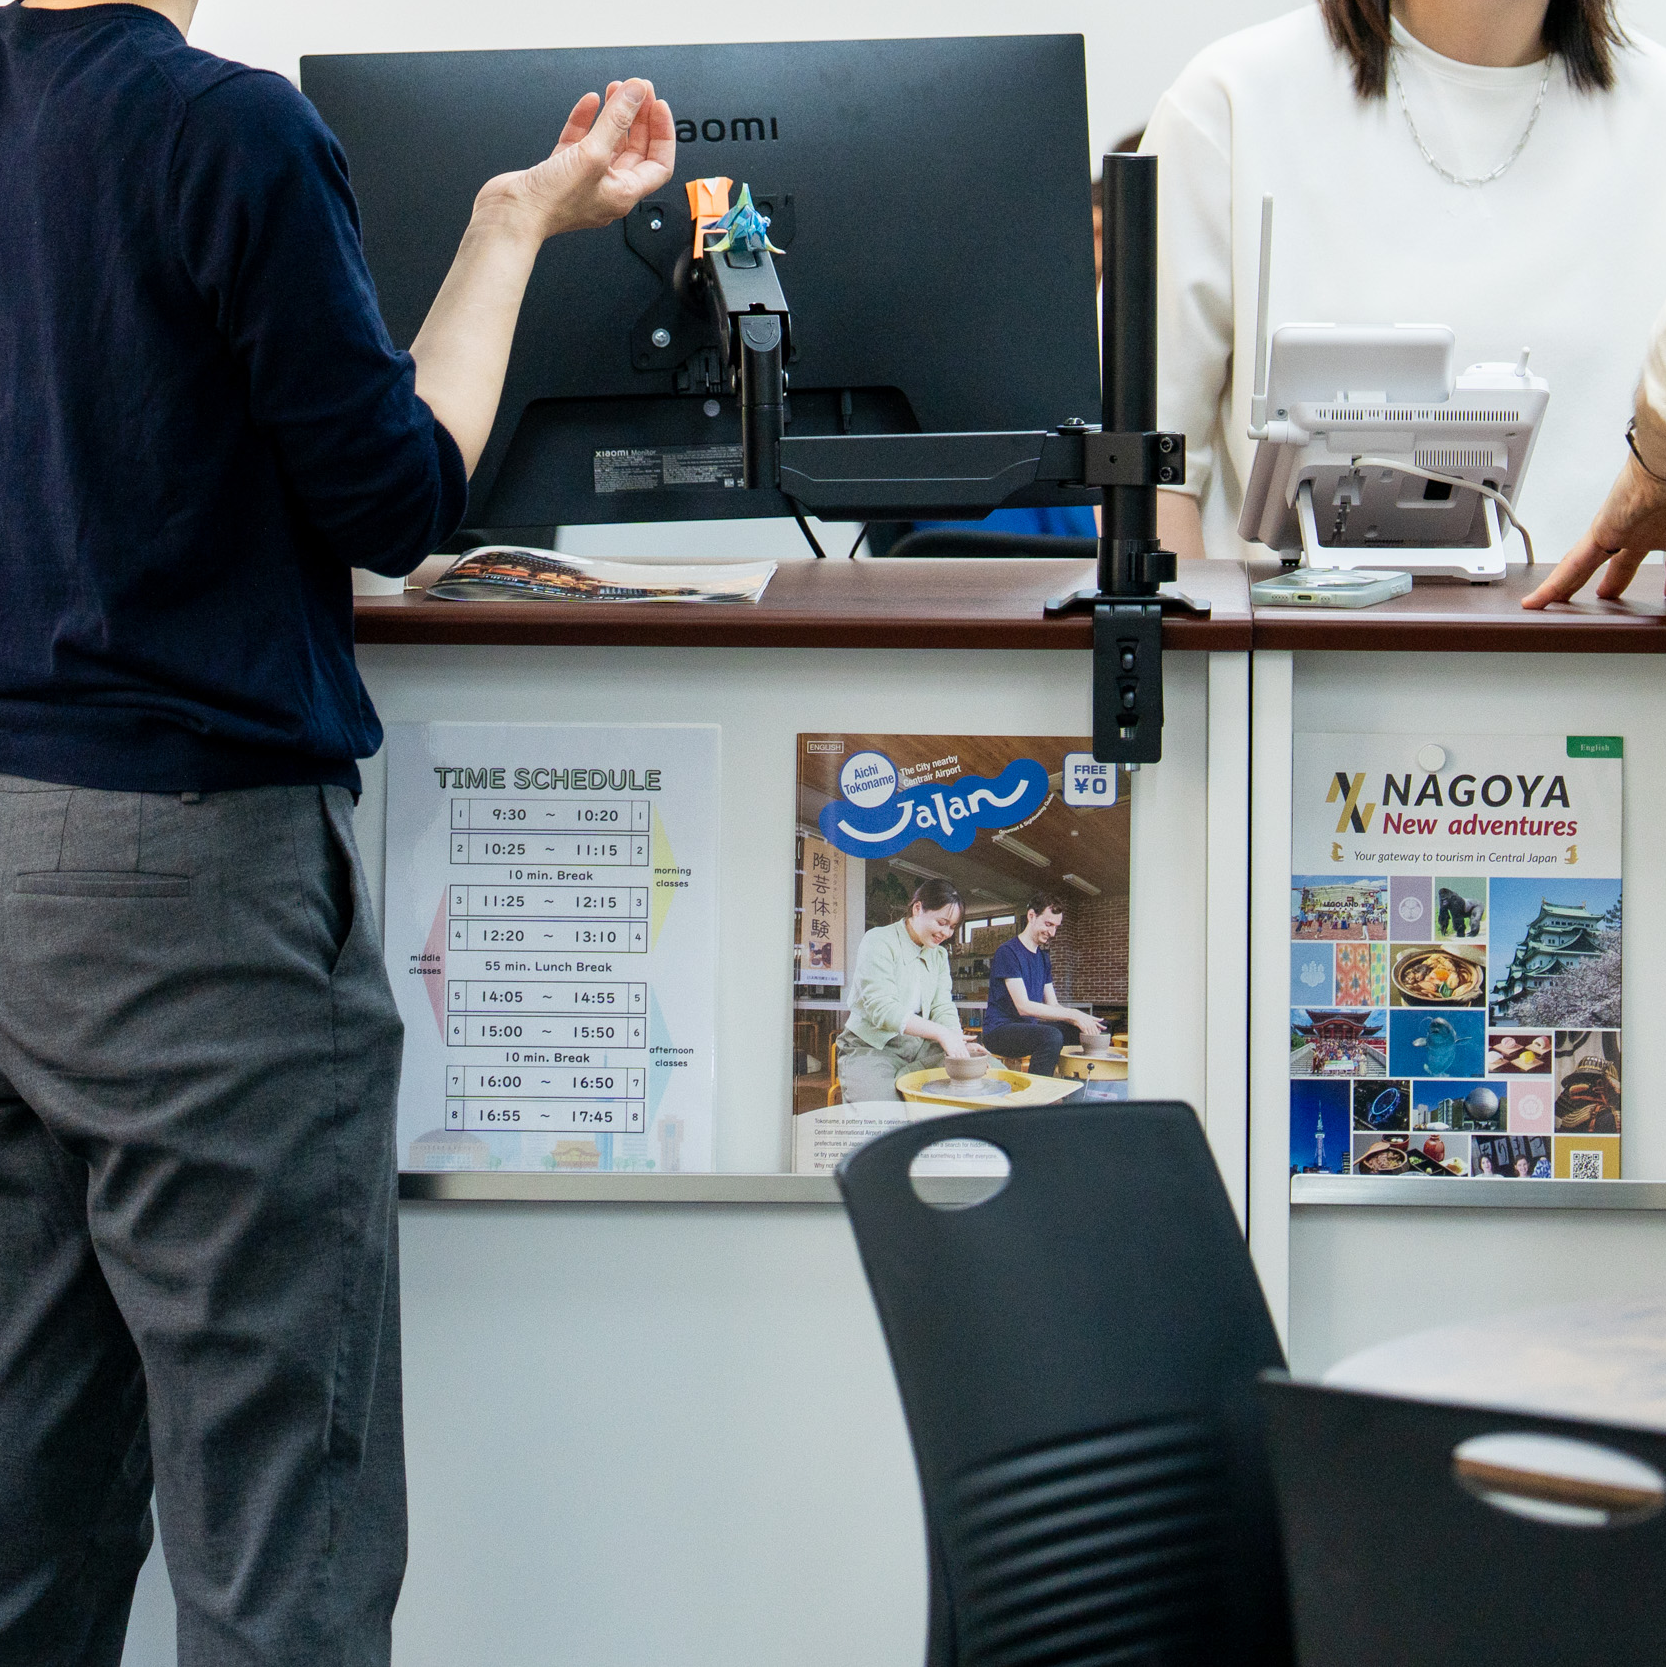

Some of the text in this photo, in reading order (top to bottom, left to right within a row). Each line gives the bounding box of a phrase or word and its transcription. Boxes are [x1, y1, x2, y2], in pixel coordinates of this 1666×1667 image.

[675, 117, 778, 143] aomi
[1580, 744, 1610, 753] English
[854, 764, 879, 780] Aichi
[900, 755, 959, 777] The City nearby
[1074, 765, 1107, 775] FREE
[434, 767, 662, 791] TIME SCHEDULE
[903, 764, 962, 788] Centrair Airport
[843, 773, 895, 797] Tokoname
[1382, 772, 1571, 809] NAGOYA
[493, 809, 527, 821] 9:30
[577, 810, 619, 822] 10:20
[837, 778, 1029, 843] Jalan
[1383, 812, 1578, 837] New adventures
[485, 843, 526, 856] 10:25
[577, 844, 618, 857] 11:15
[1355, 850, 1558, 865] Your gateway to tourism in Central Japan
[509, 870, 594, 881] 10 min. Break
[654, 866, 692, 877] morning
[656, 879, 689, 888] classes
[484, 896, 525, 908] 11:25
[576, 897, 617, 909] 12:15
[811, 852, 831, 940] 陶芸体験
[483, 930, 525, 943] 12:20
[575, 931, 617, 943] 13:10
[410, 953, 441, 963] middle
[409, 966, 442, 975] classes
[485, 961, 613, 973] 55 min. Lunch Break
[483, 990, 523, 1003] 14:05
[575, 992, 615, 1004] 14:55
[482, 1025, 523, 1038] 15:00
[574, 1026, 615, 1039] 15:50
[649, 1046, 694, 1055] afternoon
[506, 1052, 590, 1063] 10 min. Break
[655, 1059, 688, 1068] classes
[480, 1076, 522, 1088] 16:00
[573, 1077, 614, 1089] 16:50
[479, 1110, 521, 1122] 16:55
[572, 1111, 613, 1123] 17:45
[815, 1118, 841, 1126] Tokoname,
[845, 1118, 863, 1126] pottery
[814, 1140, 842, 1148] prefectures
[814, 1162, 825, 1170] Why
